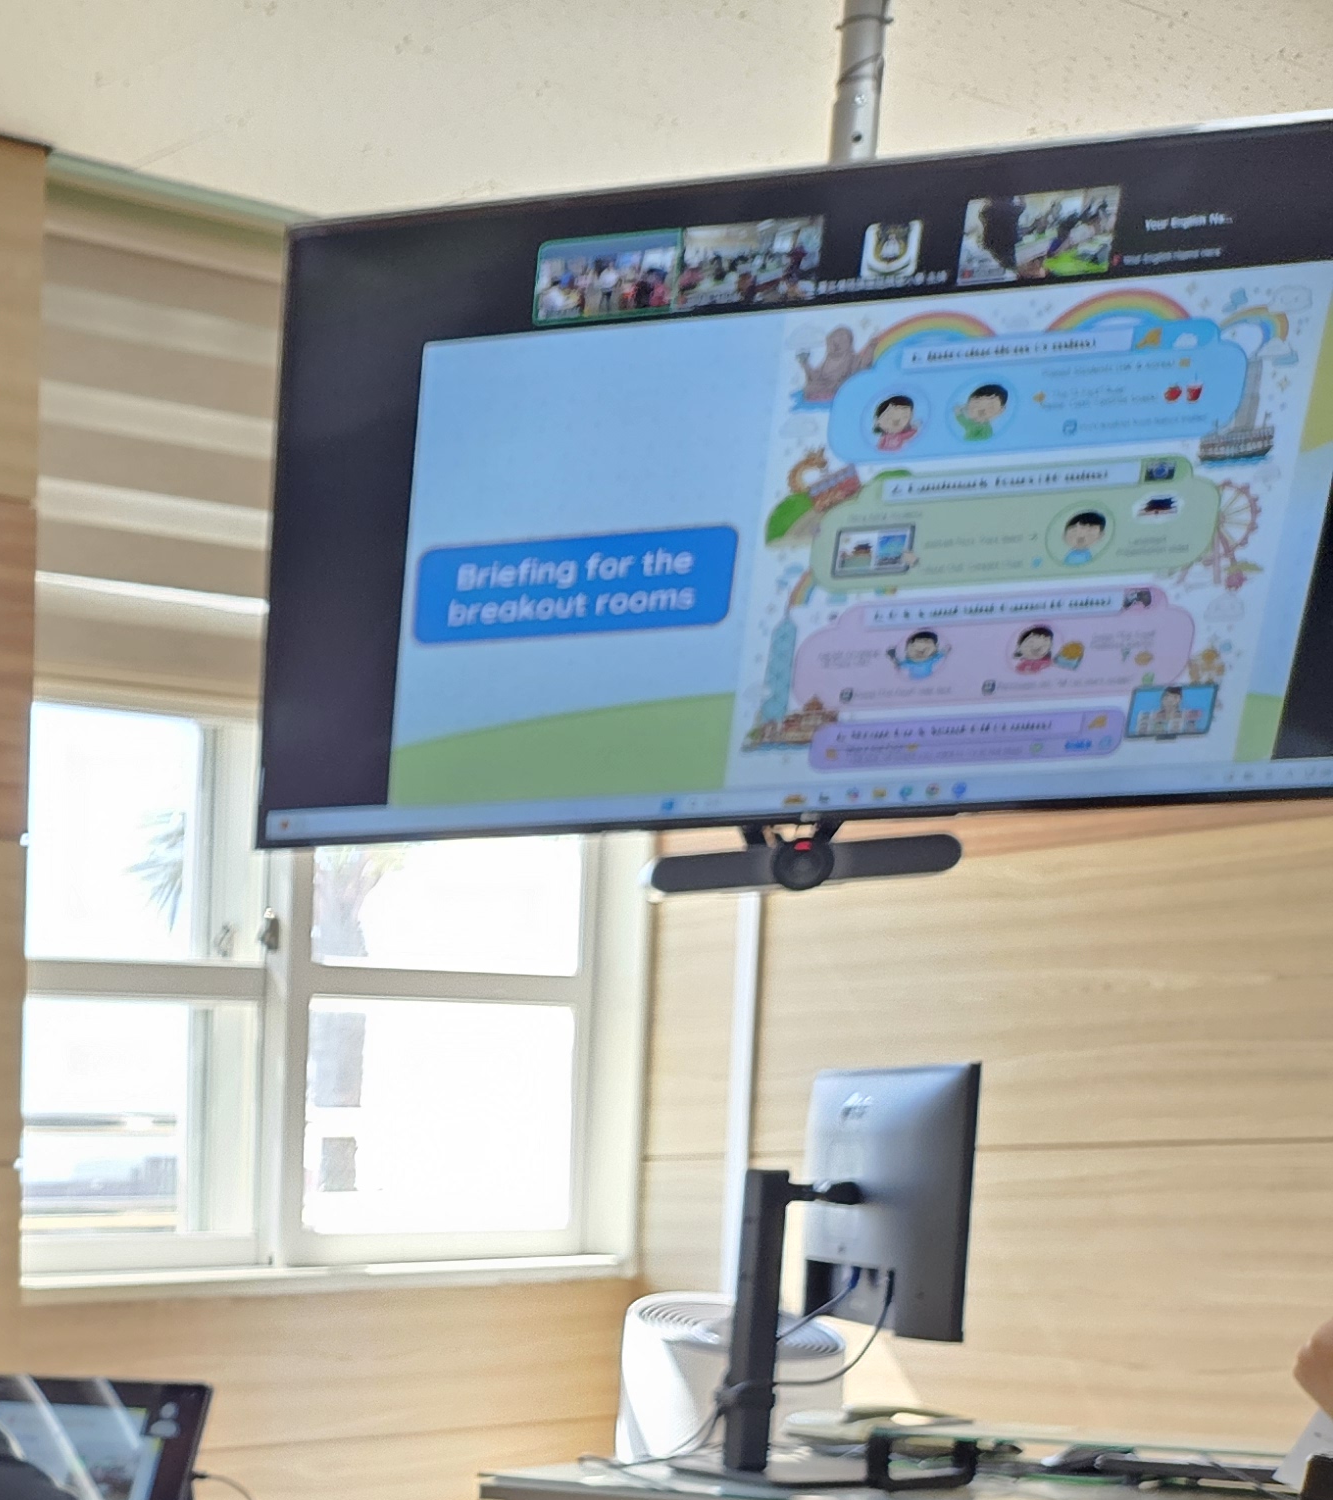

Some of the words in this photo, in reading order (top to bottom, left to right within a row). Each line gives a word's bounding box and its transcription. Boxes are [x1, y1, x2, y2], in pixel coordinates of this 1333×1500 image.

[456, 557, 578, 591] Briefing
[585, 552, 635, 581] for
[642, 547, 695, 577] the
[447, 592, 589, 628] breakout
[594, 586, 696, 617] rooms
